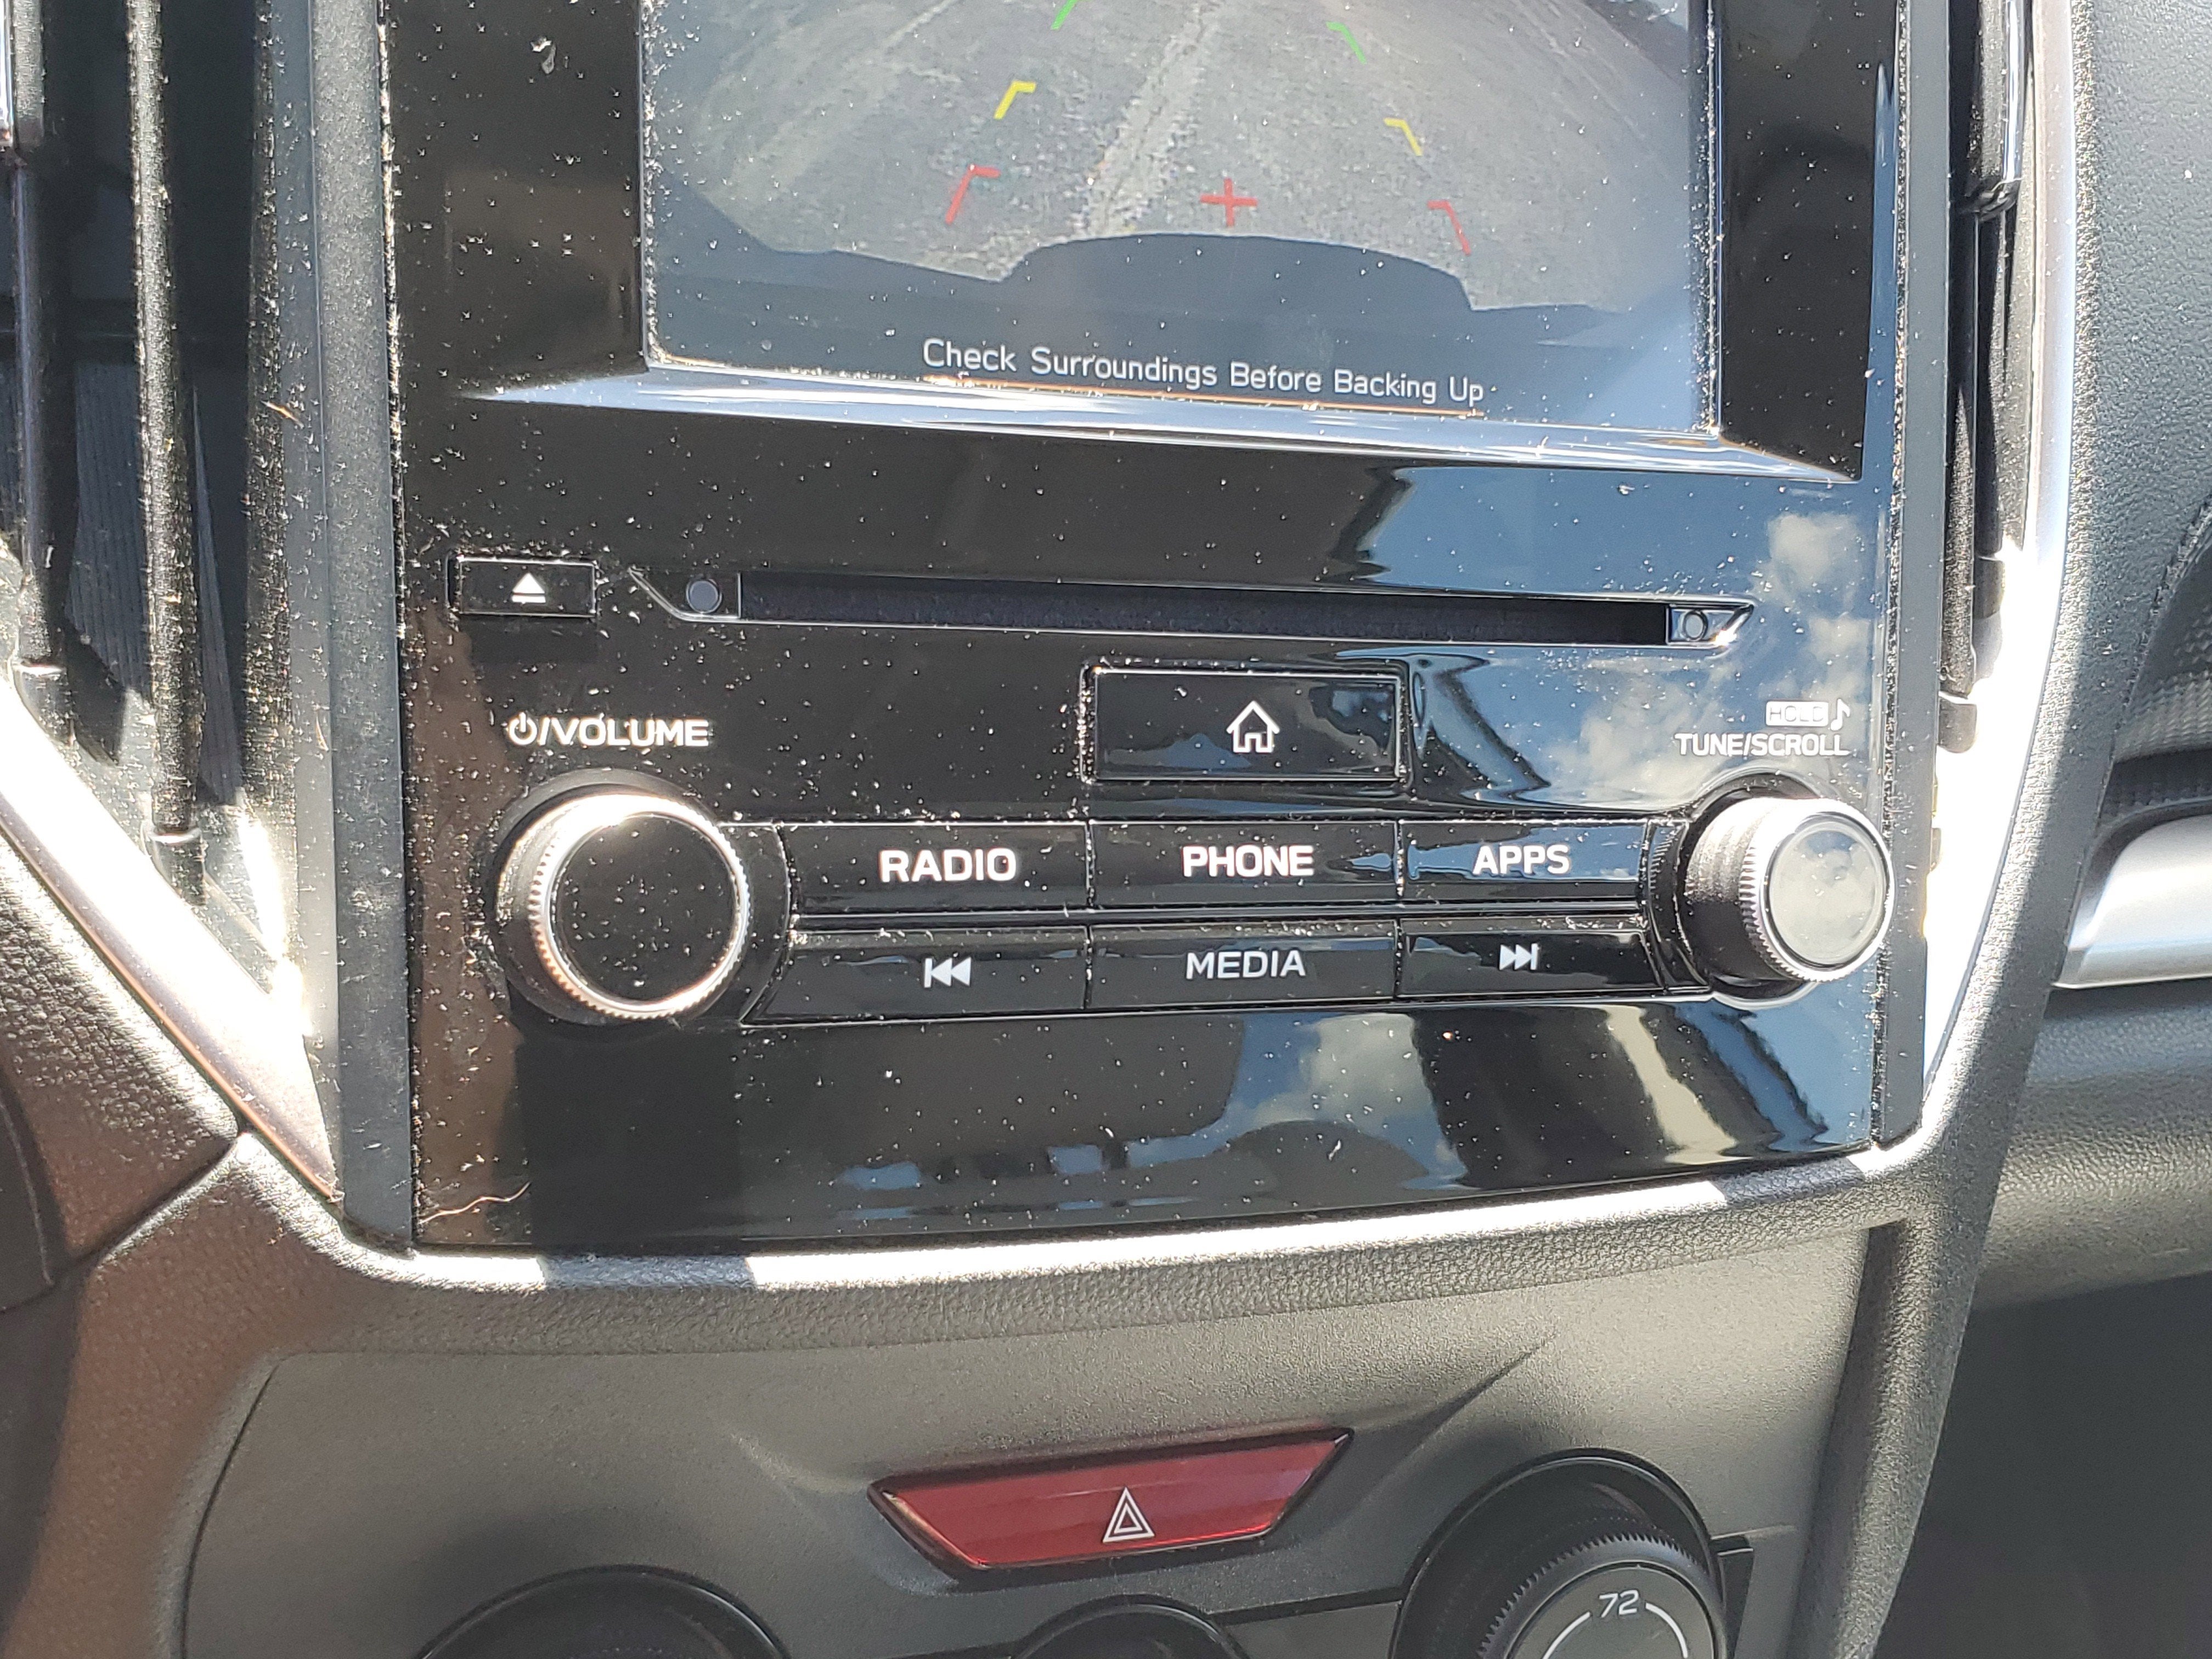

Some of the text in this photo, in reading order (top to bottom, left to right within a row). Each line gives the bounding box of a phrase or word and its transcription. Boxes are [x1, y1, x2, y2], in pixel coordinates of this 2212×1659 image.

[923, 337, 1483, 407] Check Surroundings Before Backing Up
[1674, 733, 1850, 756] TUNE/SCROLL
[879, 848, 1017, 882] RADIO
[1182, 845, 1314, 877] PHONE
[1473, 844, 1572, 876] APPS
[1186, 950, 1306, 980] MEDIA
[1599, 1589, 1639, 1618] 72
